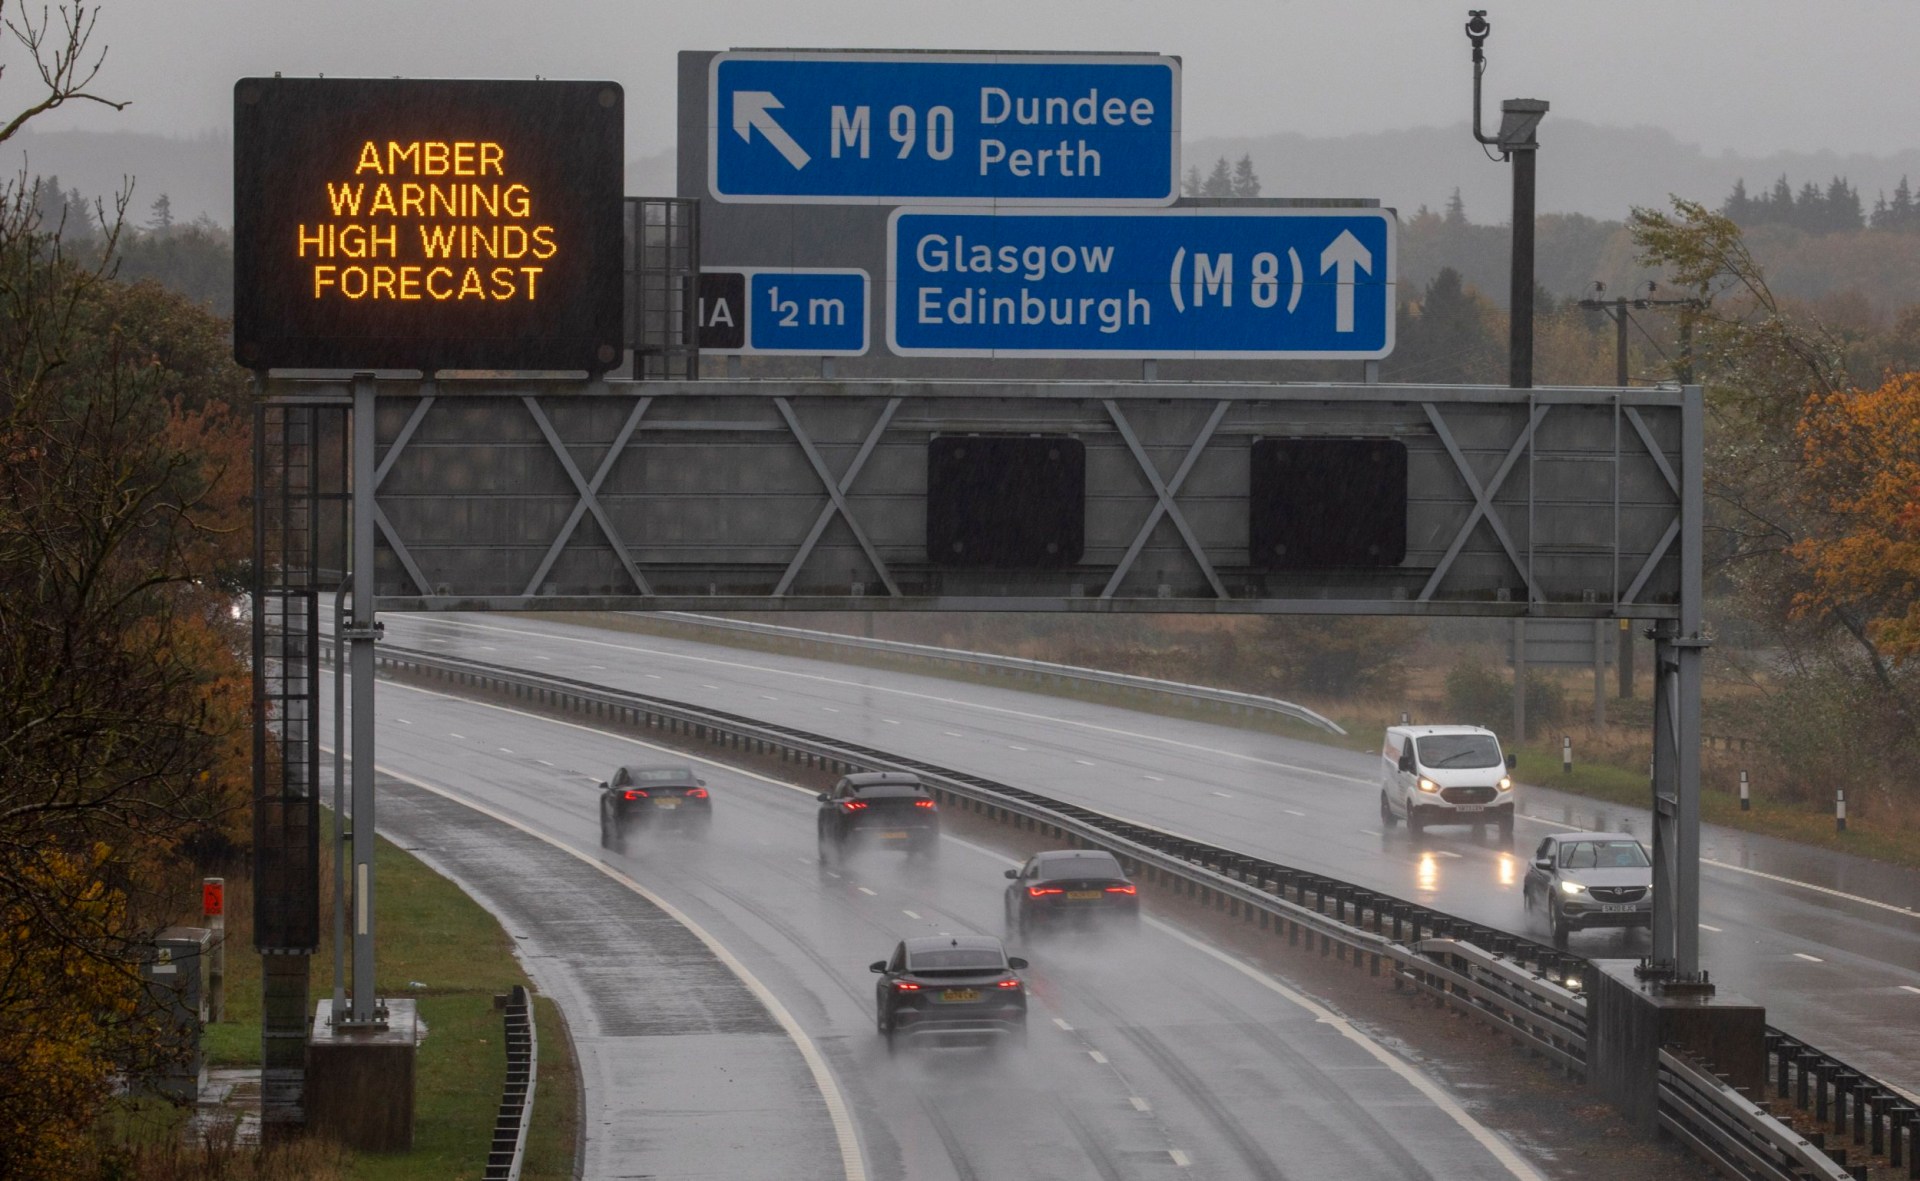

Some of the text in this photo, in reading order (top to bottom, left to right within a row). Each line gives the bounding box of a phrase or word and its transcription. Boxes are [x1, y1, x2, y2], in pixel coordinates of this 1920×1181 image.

[981, 87, 1154, 126] Dundee
[356, 142, 503, 176] AMBER
[980, 139, 1101, 177] Perth
[328, 183, 529, 217] WARNING
[299, 225, 557, 259] HIGH WINDS
[916, 234, 1114, 281] Glasgow
[315, 266, 543, 300] FORECAST
[809, 298, 844, 325] m
[918, 287, 1151, 333] Edinburgh
